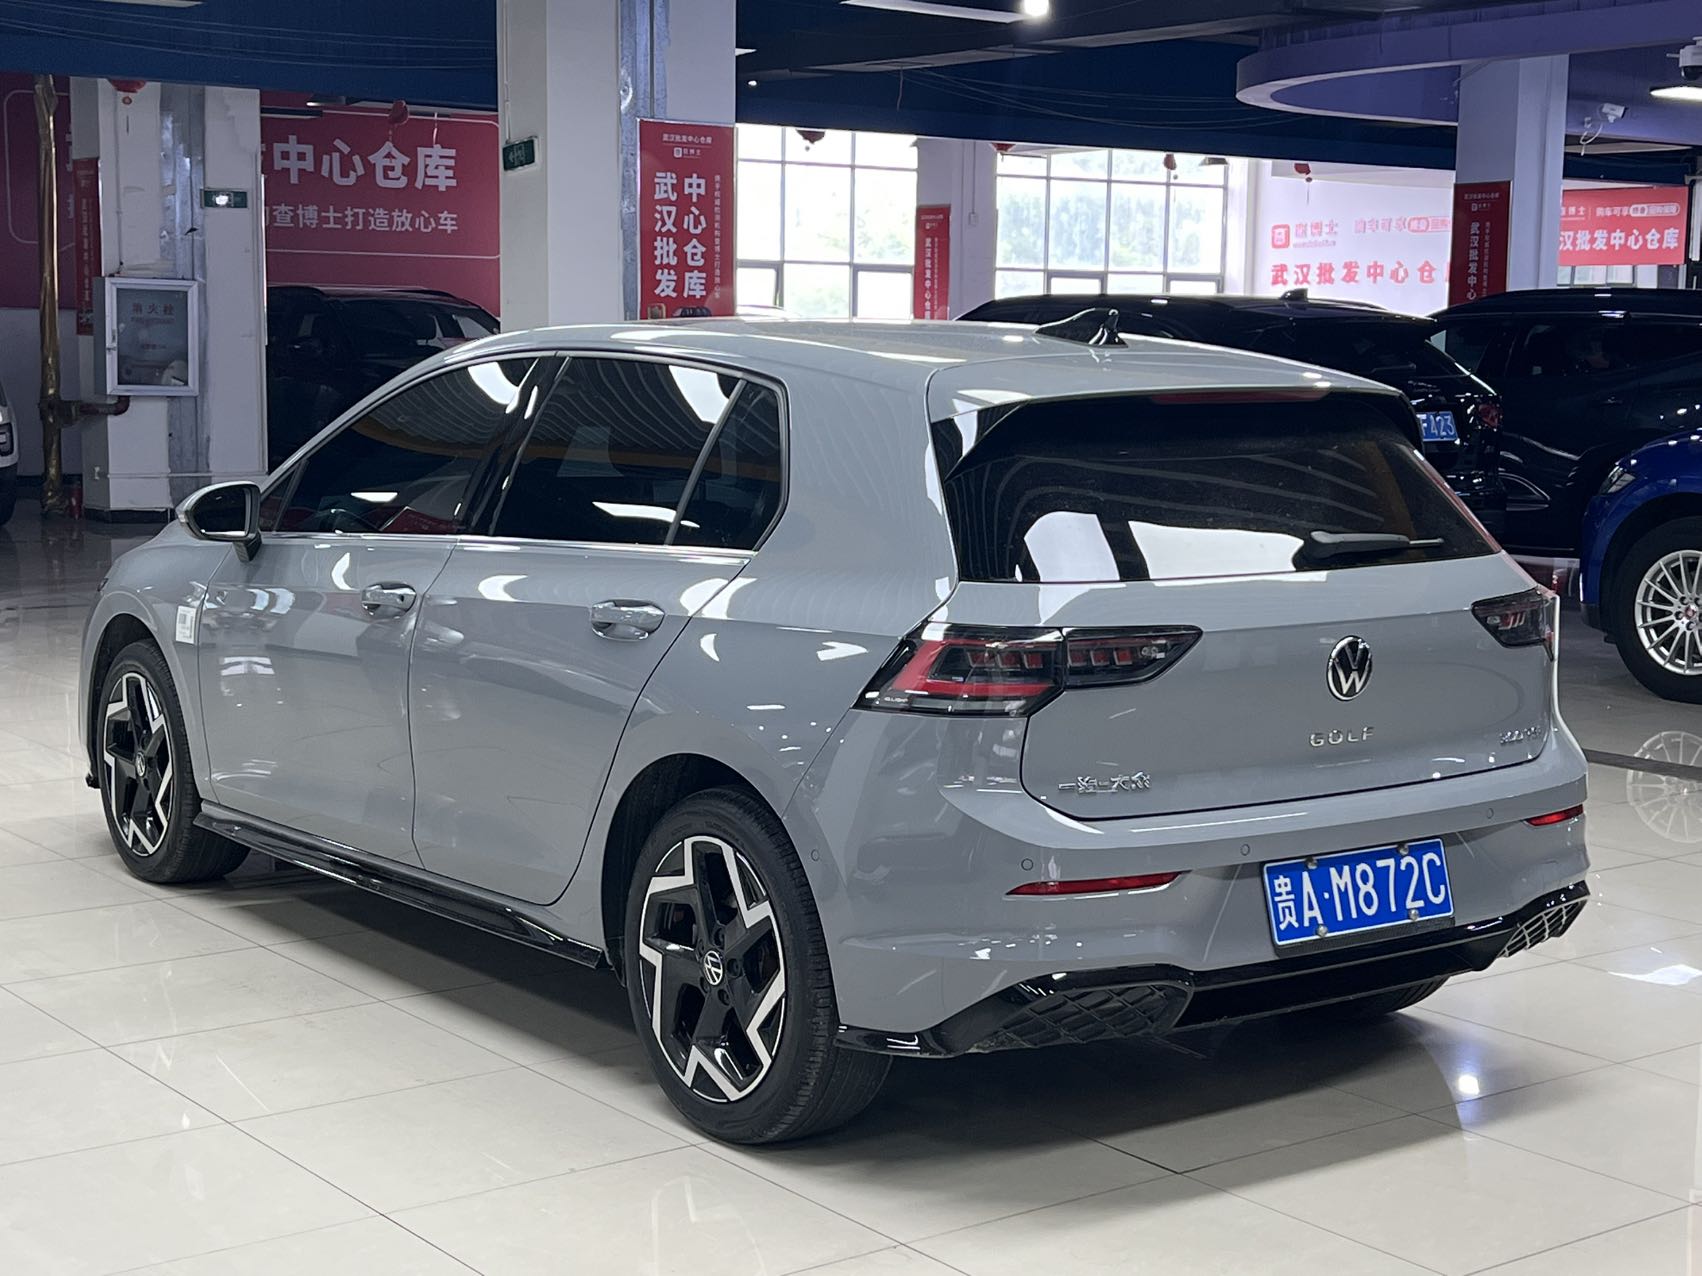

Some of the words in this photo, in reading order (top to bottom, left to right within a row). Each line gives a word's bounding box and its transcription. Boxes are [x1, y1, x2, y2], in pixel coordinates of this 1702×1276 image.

[262, 134, 457, 191] 中心仓库
[265, 203, 459, 234] 查博士打造放心车
[654, 171, 678, 298] 武汉批发
[682, 173, 707, 298] 中心仓库
[1270, 260, 1452, 286] 武汉批发中心仓
[1310, 727, 1375, 747] GOLF
[1273, 852, 1446, 931] 贵A·M872C
